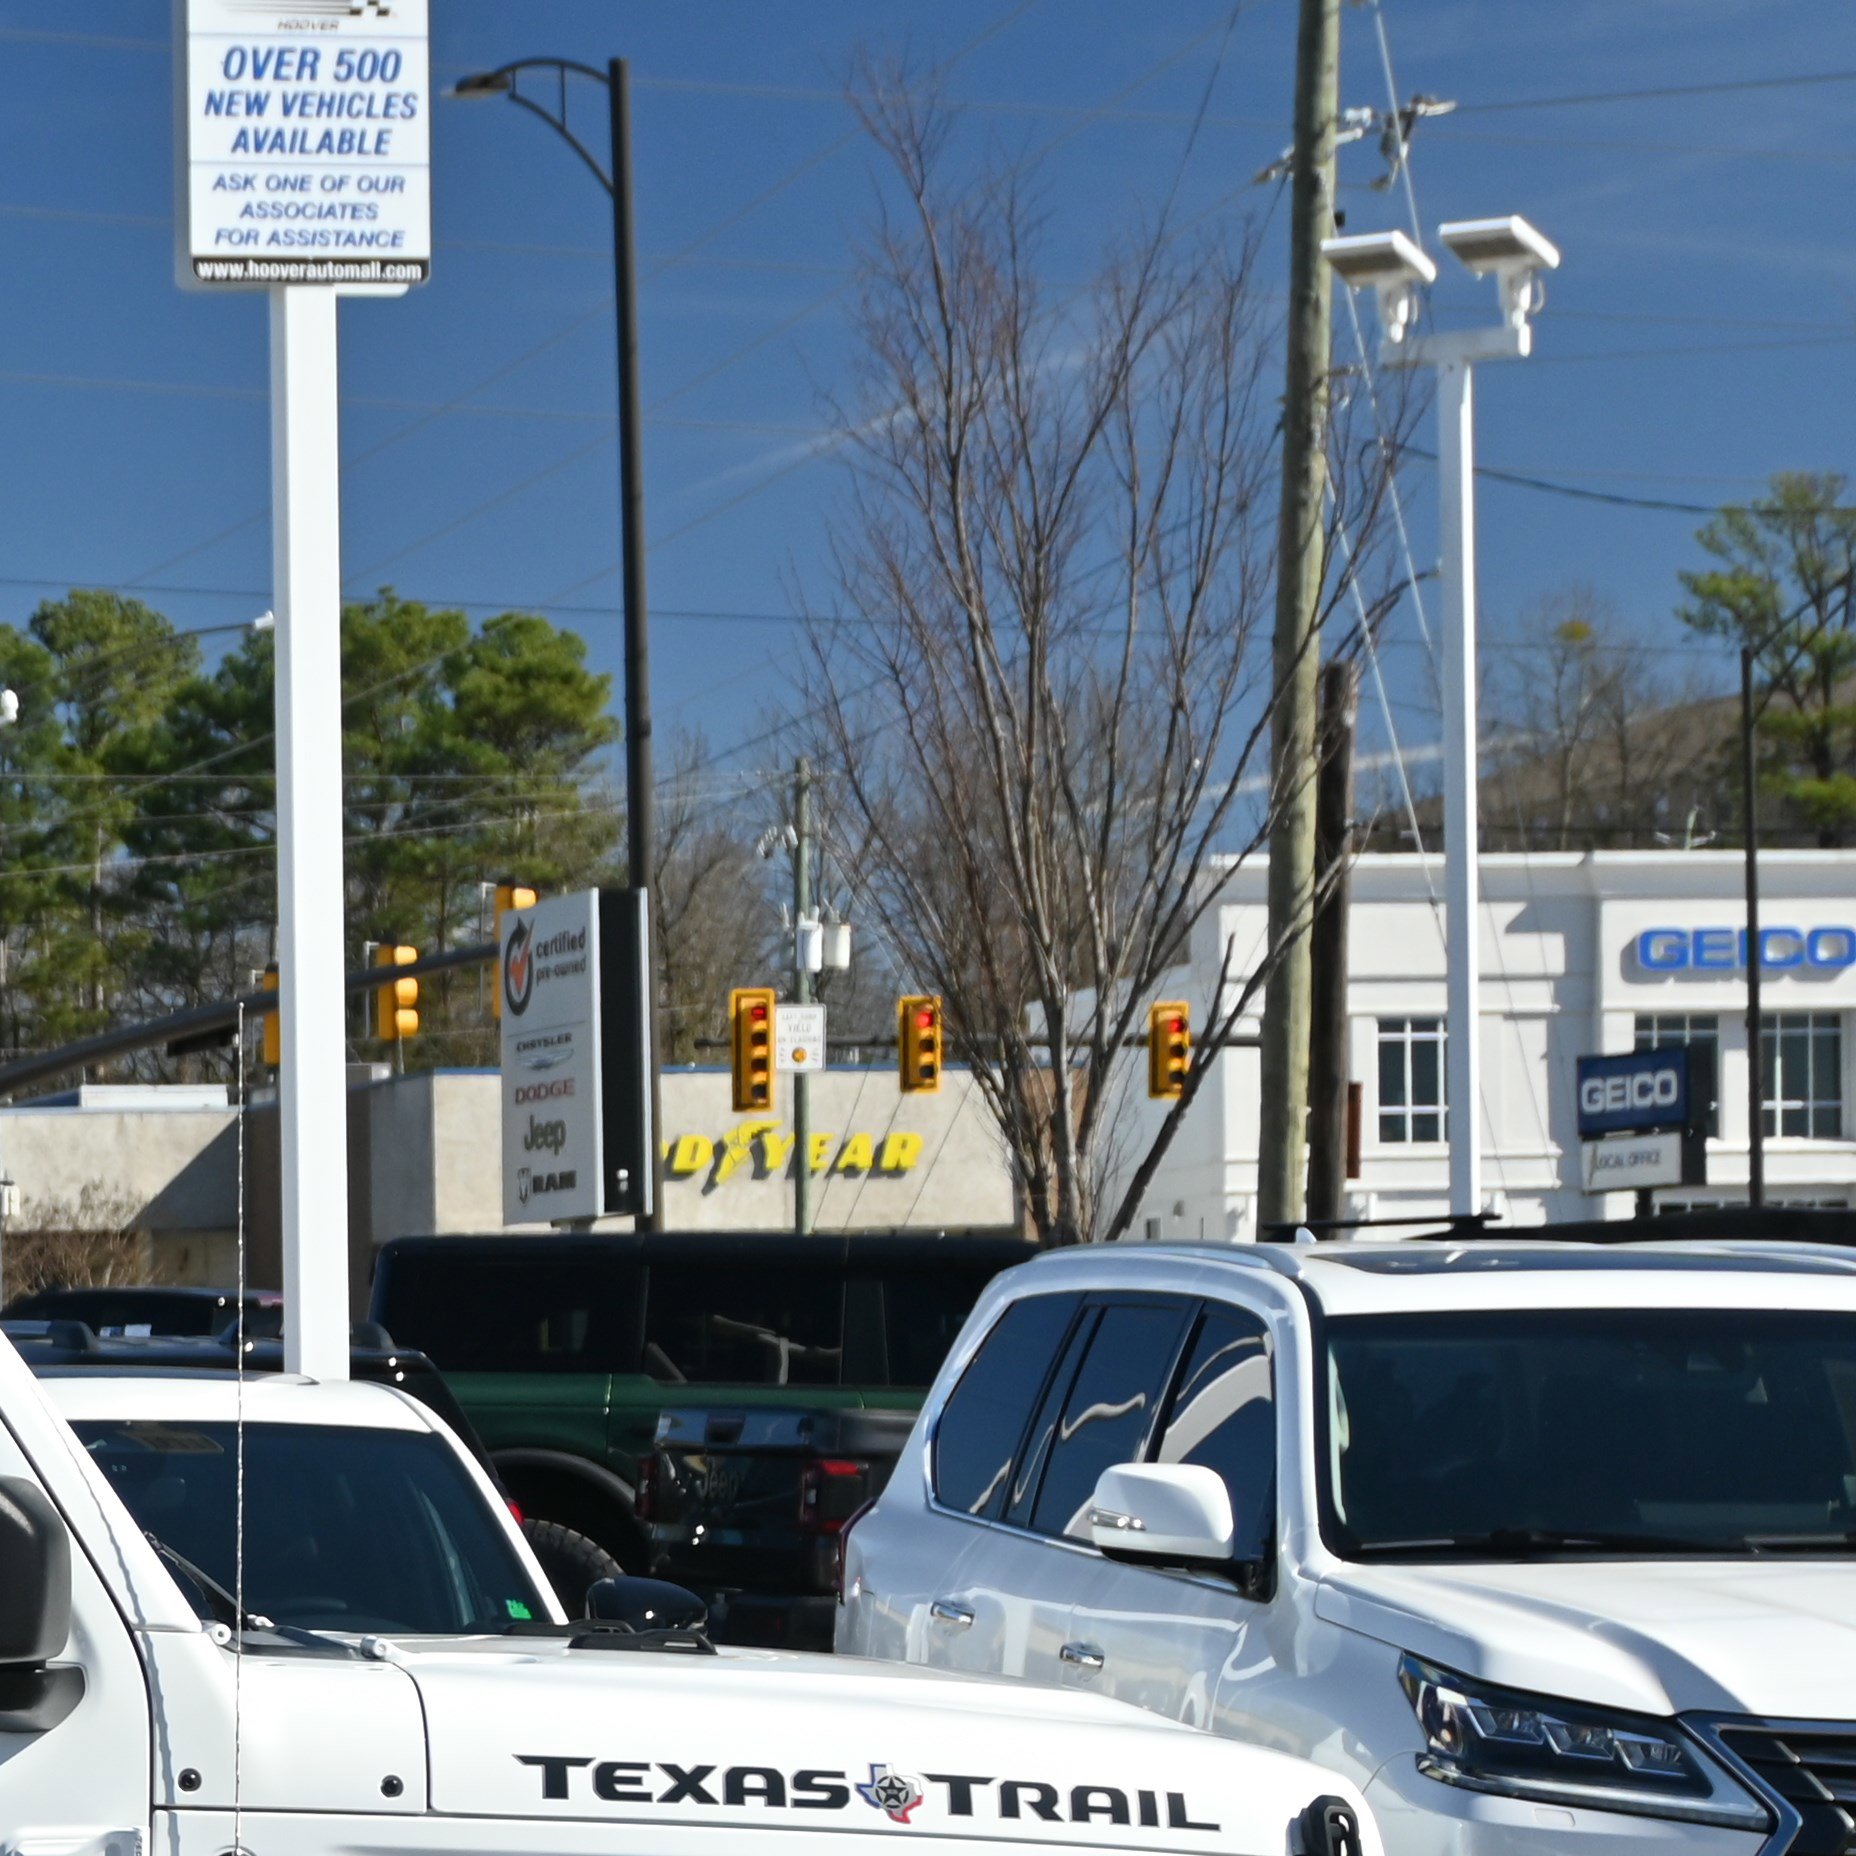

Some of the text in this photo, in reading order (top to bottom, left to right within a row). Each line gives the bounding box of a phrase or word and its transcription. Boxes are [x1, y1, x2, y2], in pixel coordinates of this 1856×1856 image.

[277, 20, 339, 31] HOOVER
[223, 46, 403, 83] OVER 500
[205, 90, 418, 120] NEW VEHICLES
[231, 128, 392, 155] AVAILABLE
[212, 173, 406, 193] ASK ONE OF OUR
[239, 202, 379, 220] ASSOCIATES
[214, 229, 405, 248] FOR ASSISTANCE
[197, 260, 423, 280] www.hooverautomall.com
[536, 926, 586, 957] certified
[1638, 927, 1856, 969] GEICO
[516, 1033, 572, 1053] CHRYSLER
[515, 1078, 576, 1105] DODGE
[1581, 1069, 1678, 1114] GEICO
[524, 1114, 566, 1156] Jeep
[532, 1170, 577, 1194] RAM
[696, 1459, 739, 1507] Jeep
[512, 1753, 1223, 1833] TEXAS TRAIL
